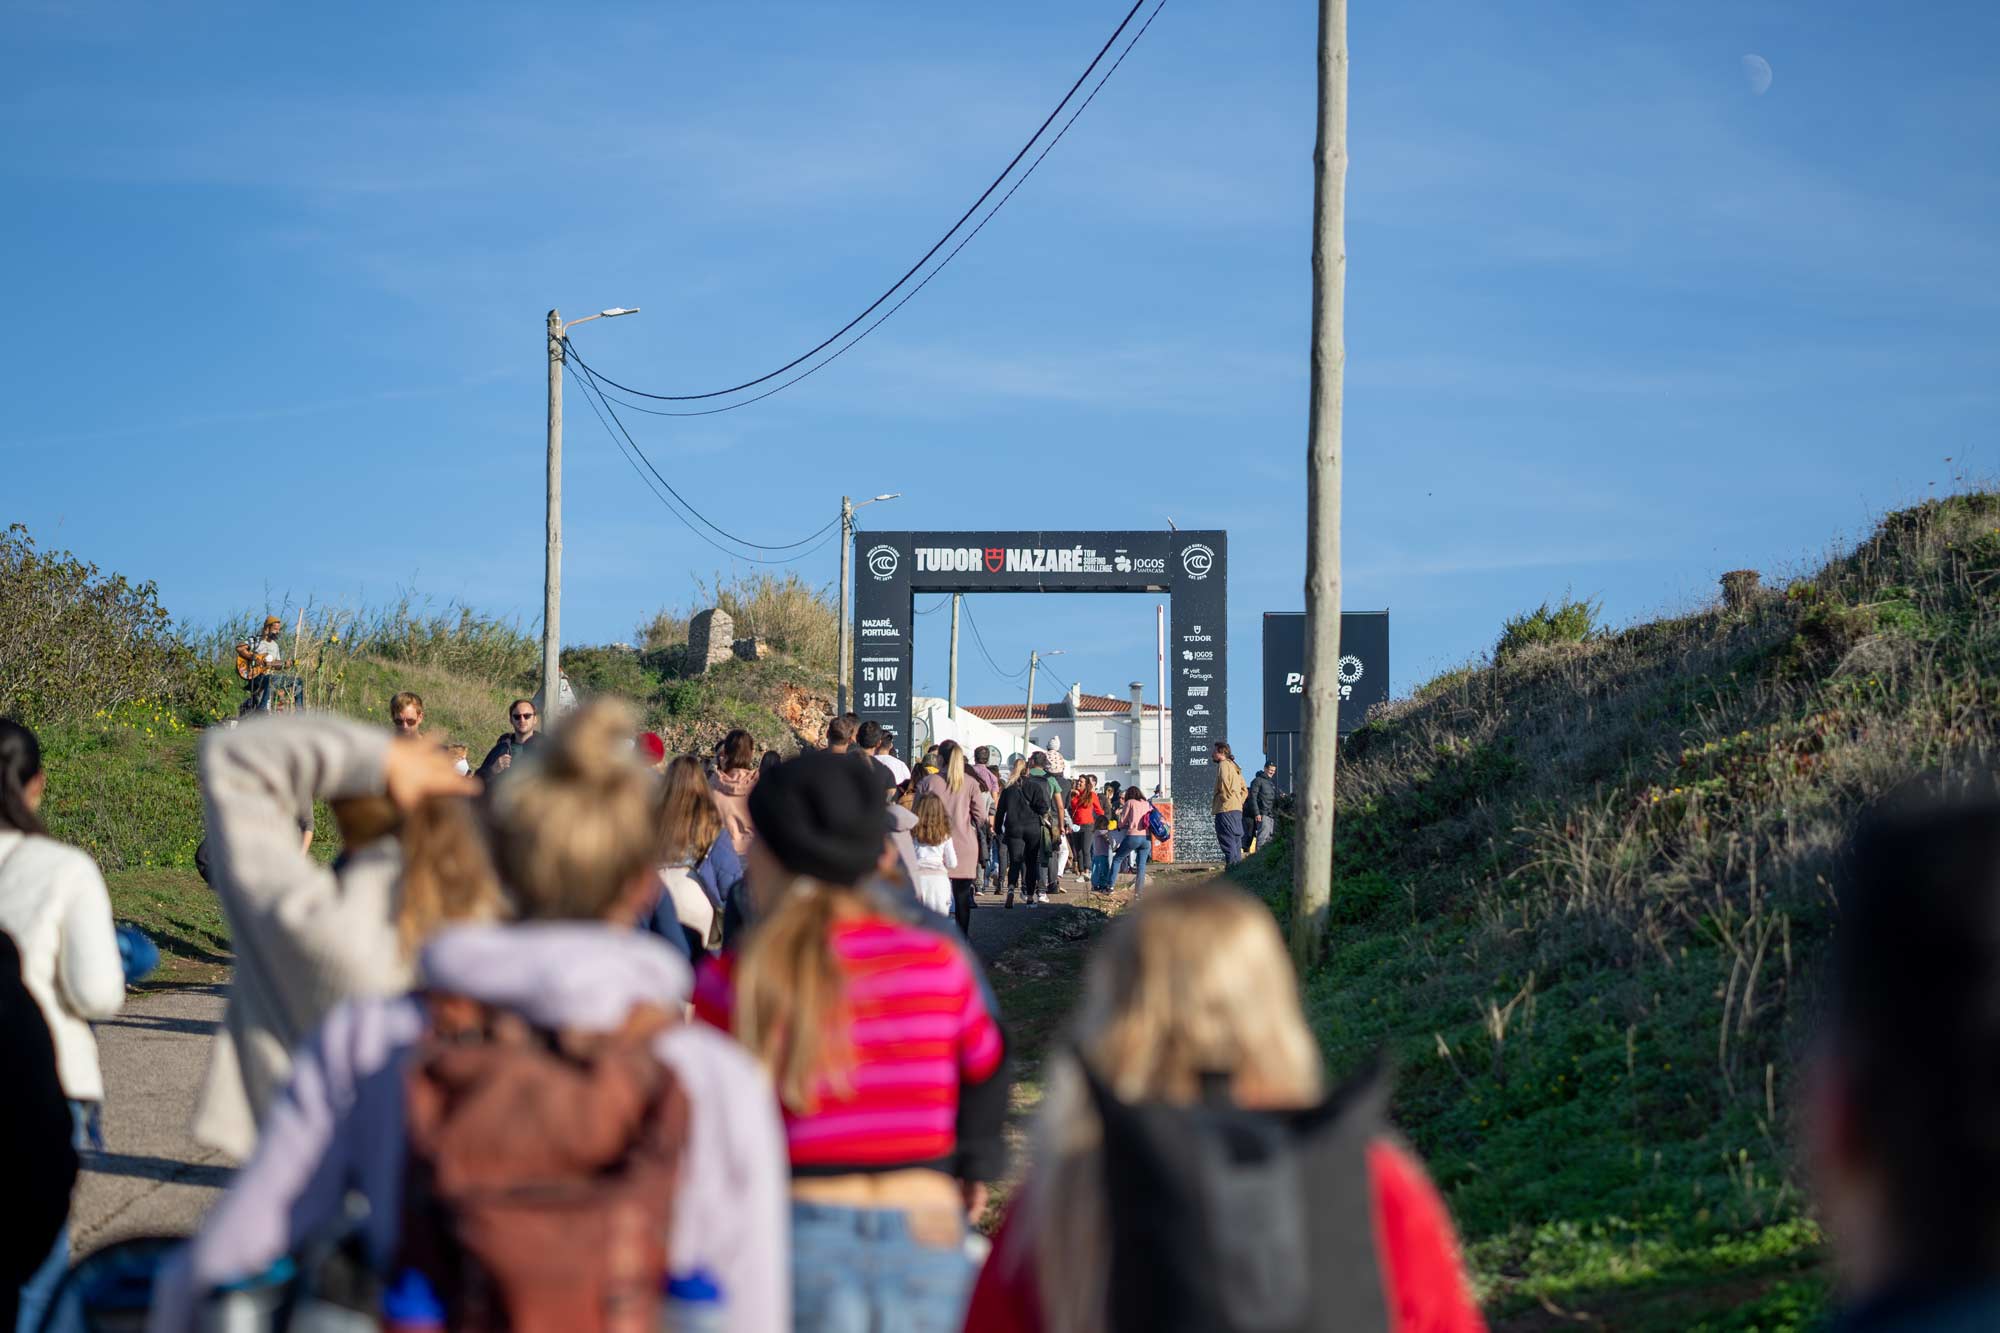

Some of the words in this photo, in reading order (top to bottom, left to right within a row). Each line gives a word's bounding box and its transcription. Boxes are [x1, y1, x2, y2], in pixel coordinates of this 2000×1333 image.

[1083, 549, 1097, 557] TOW
[914, 547, 983, 572] TUDOR
[1005, 545, 1083, 573] NAZARÉ
[1083, 557, 1106, 565] SURFING
[1083, 564, 1113, 573] CHALLENGE
[1133, 558, 1165, 571] JOGOS
[862, 618, 892, 628] NAZARÉ,
[862, 628, 900, 637] PORTUGAL
[1194, 651, 1213, 659] JOGOS
[862, 667, 874, 681] 15
[876, 667, 898, 681] NOV
[878, 682, 883, 692] A
[1289, 685, 1303, 693] do
[863, 692, 876, 707] 31
[877, 692, 897, 707] DEZ
[1186, 708, 1209, 717] Corona
[1189, 725, 1208, 734] OESTE
[1189, 757, 1208, 765] Hertz
